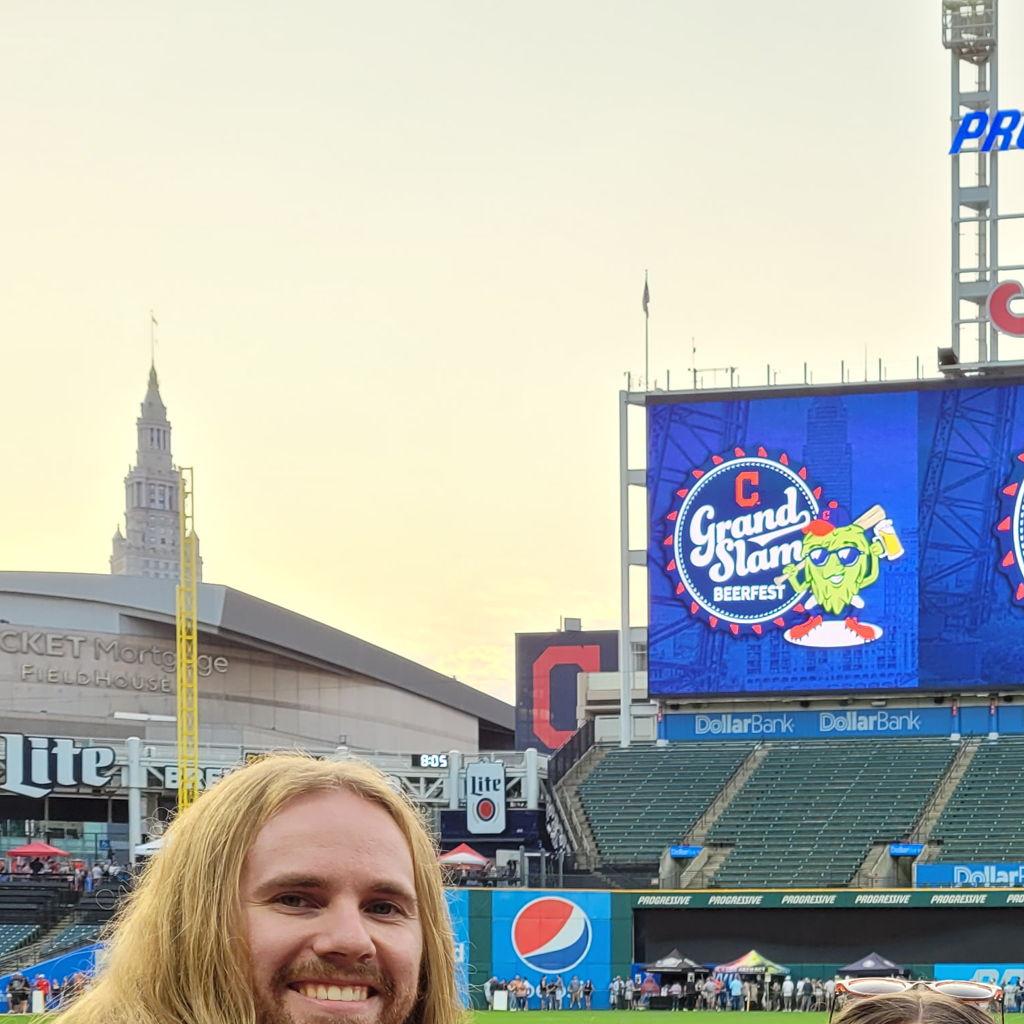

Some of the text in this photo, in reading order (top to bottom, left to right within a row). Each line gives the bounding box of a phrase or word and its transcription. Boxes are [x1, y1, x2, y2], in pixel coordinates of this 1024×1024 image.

[735, 471, 760, 508] C
[689, 486, 810, 567] Grand
[708, 538, 804, 583] Slam
[713, 584, 786, 602] BEERFEST
[93, 636, 230, 677] Mortgge
[21, 664, 173, 693] FIELDHOUSE
[533, 645, 600, 749] C
[695, 714, 794, 734] DollarBank
[819, 711, 921, 732] DollarBank
[0, 733, 116, 798] Lite
[420, 754, 448, 768] 8:05
[165, 766, 232, 790] BRE
[470, 775, 501, 796] Lite
[638, 896, 692, 905] PROGRESSIVE
[708, 895, 764, 905] PROGRESSIVE
[781, 895, 837, 904] PROGRESSIVE
[855, 894, 911, 904] PROGRESSIVE
[930, 894, 987, 904] PROGRESSIVE
